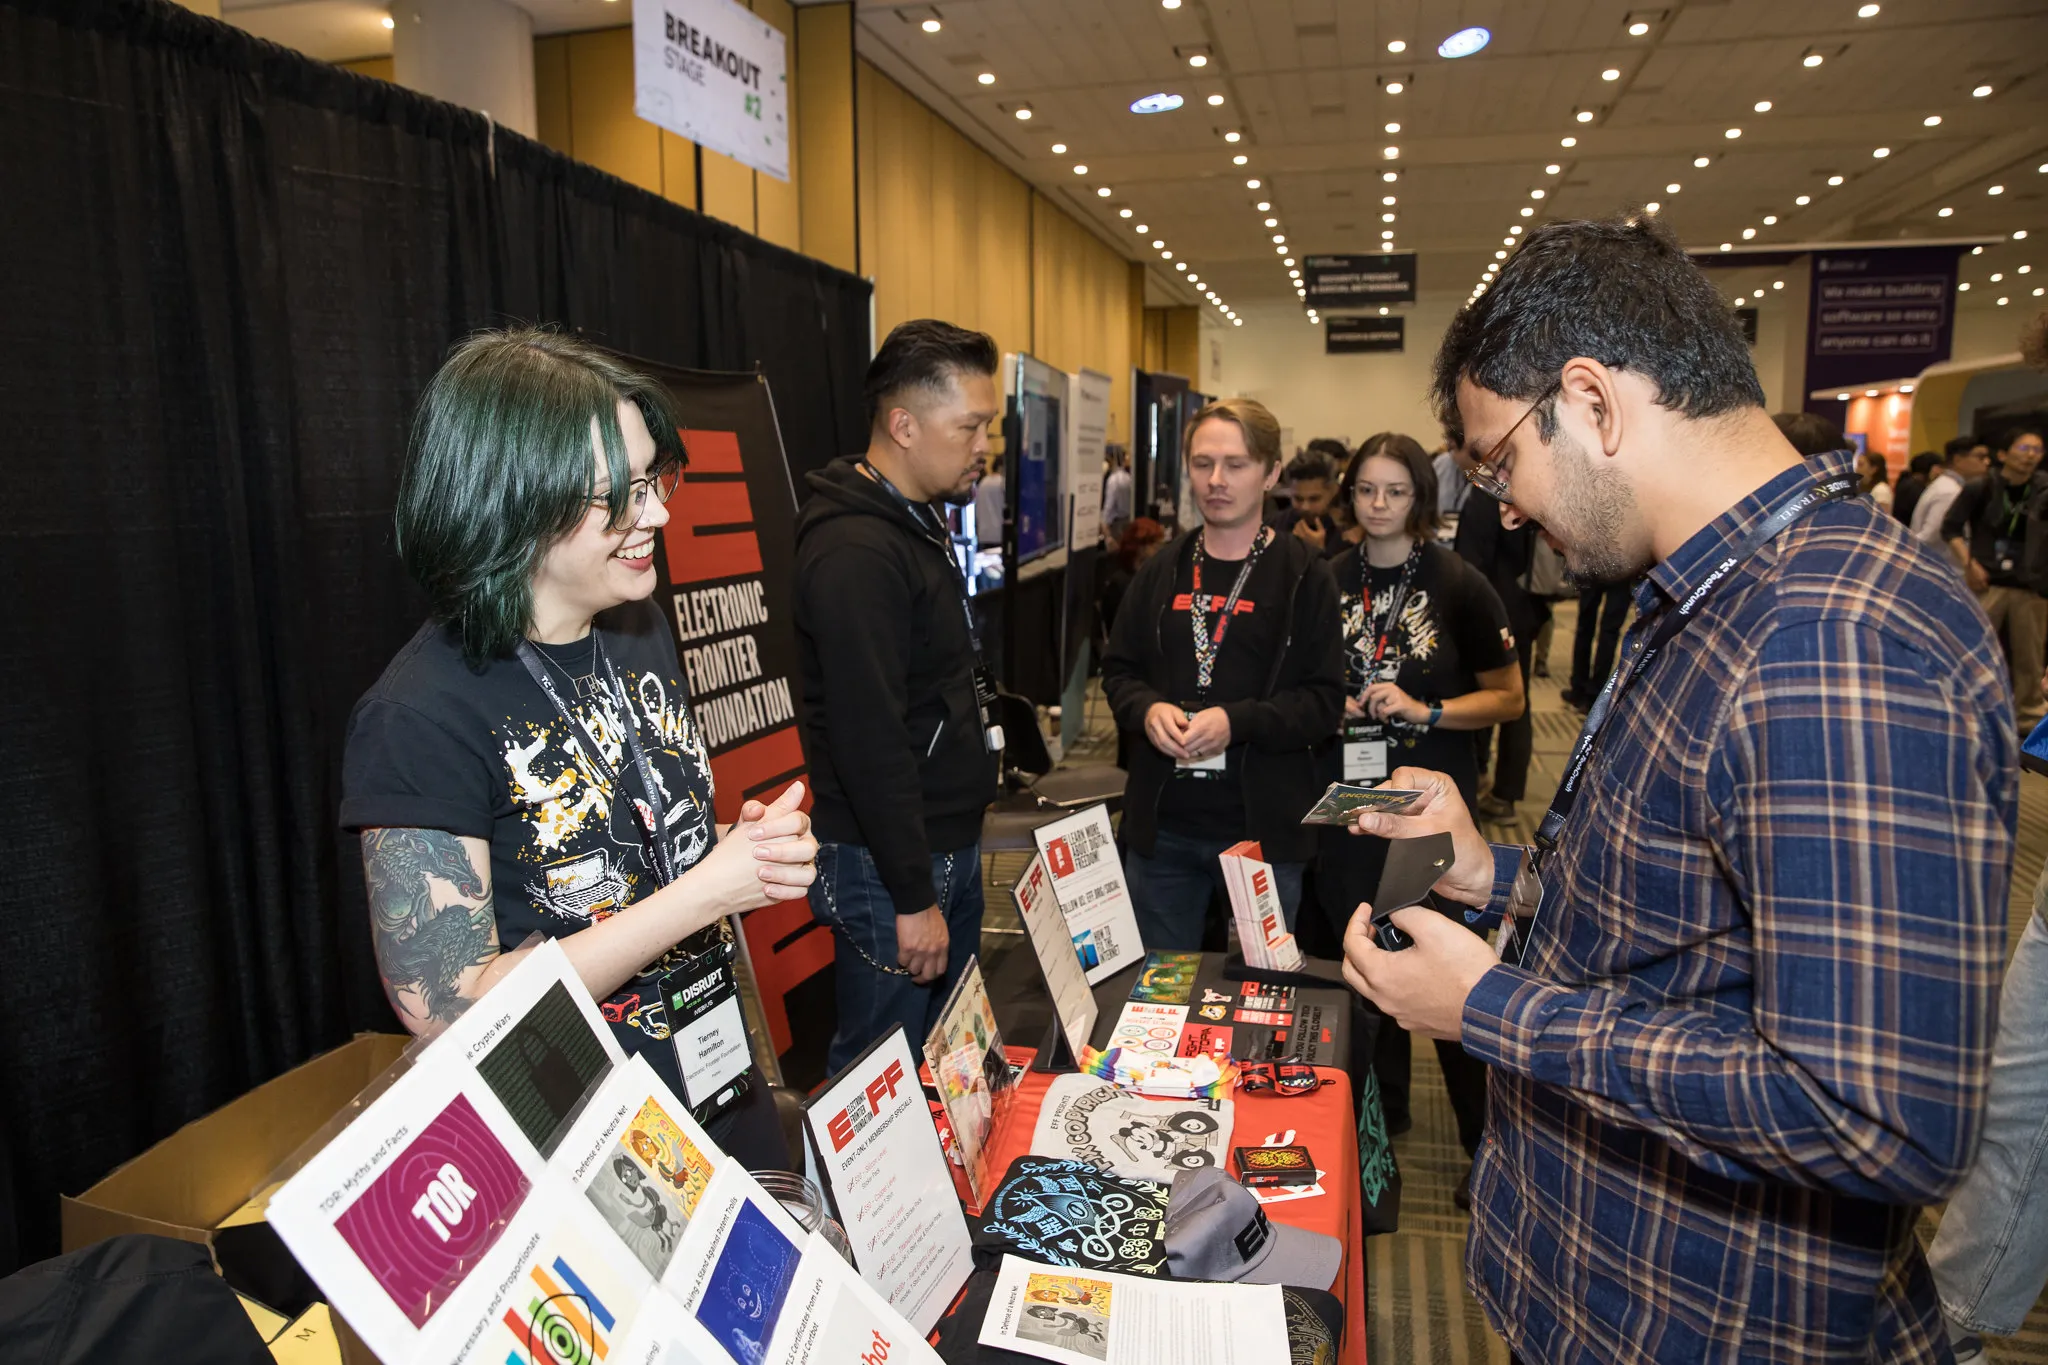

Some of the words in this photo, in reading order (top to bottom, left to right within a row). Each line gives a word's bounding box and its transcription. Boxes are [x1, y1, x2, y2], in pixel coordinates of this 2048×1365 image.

[663, 10, 761, 91] BREAKOUT
[663, 45, 706, 87] STAGE
[744, 94, 762, 120] #2
[1846, 285, 1882, 297] make
[1885, 283, 1941, 298] building
[1823, 310, 1882, 324] software
[1885, 312, 1901, 322] so
[1904, 310, 1937, 323] easy
[1821, 336, 1869, 350] anyone
[1872, 335, 1897, 347] can
[1901, 334, 1917, 346] do
[1920, 333, 1930, 345] it
[1827, 480, 1851, 493] TRADE
[1776, 493, 1816, 521] TRAVEL
[1678, 571, 1724, 616] TechCrunch
[673, 579, 768, 642] ELECTRONIC
[683, 634, 762, 698] FRONTIER
[541, 675, 551, 689] TC
[548, 686, 576, 725] TechCrunch
[694, 676, 794, 749] FOUNDATION
[597, 756, 615, 779] TRADE
[645, 778, 658, 805] TRADE
[1068, 829, 1086, 846] LEARN
[1071, 841, 1090, 857] ABOUT
[682, 967, 722, 1003] DISRUPT
[473, 1029, 495, 1052] Crypto
[493, 1013, 511, 1031] Wars
[698, 1027, 720, 1045] Tierney
[685, 1065, 705, 1082] Electronic
[705, 1057, 720, 1073] Frontier
[720, 1043, 742, 1061] Foundation
[698, 1039, 725, 1060] Hamilton
[617, 1104, 628, 1119] Net
[826, 1058, 907, 1154] EFF
[849, 1104, 865, 1124] FRONTIER
[1054, 1095, 1071, 1118] PRESENTS
[602, 1114, 621, 1140] Neutral
[841, 1139, 868, 1171] EVENT-ONLY
[867, 1113, 894, 1145] MEMBERSHIP
[894, 1095, 912, 1118] SPECIALS
[853, 1110, 873, 1134] FOUNDATION
[1051, 1118, 1060, 1130] EFF
[595, 1140, 602, 1152] of
[600, 1137, 606, 1145] a
[319, 1187, 344, 1215] TOR:
[343, 1163, 371, 1193] Myths
[370, 1144, 387, 1167] and
[385, 1124, 409, 1150] Facts
[575, 1149, 597, 1178] Defense
[411, 1162, 477, 1242] TOR
[725, 1196, 738, 1220] Trolls
[716, 1213, 730, 1236] Patent
[881, 1229, 894, 1247] Member
[913, 1195, 922, 1208] Pack
[886, 1214, 895, 1228] Gold
[705, 1234, 721, 1259] Against
[487, 1292, 502, 1316] and
[499, 1232, 541, 1294] Proportionate
[695, 1278, 702, 1286] A
[697, 1258, 710, 1282] Stand
[683, 1285, 700, 1312] Taking
[1000, 1313, 1012, 1330] Defense
[1008, 1292, 1017, 1305] Neutral
[790, 1312, 810, 1354] Certificates
[805, 1294, 817, 1313] from
[814, 1277, 823, 1295] Let's
[295, 1327, 317, 1342] M
[804, 1322, 819, 1352] Certbot
[800, 1349, 809, 1365] and
